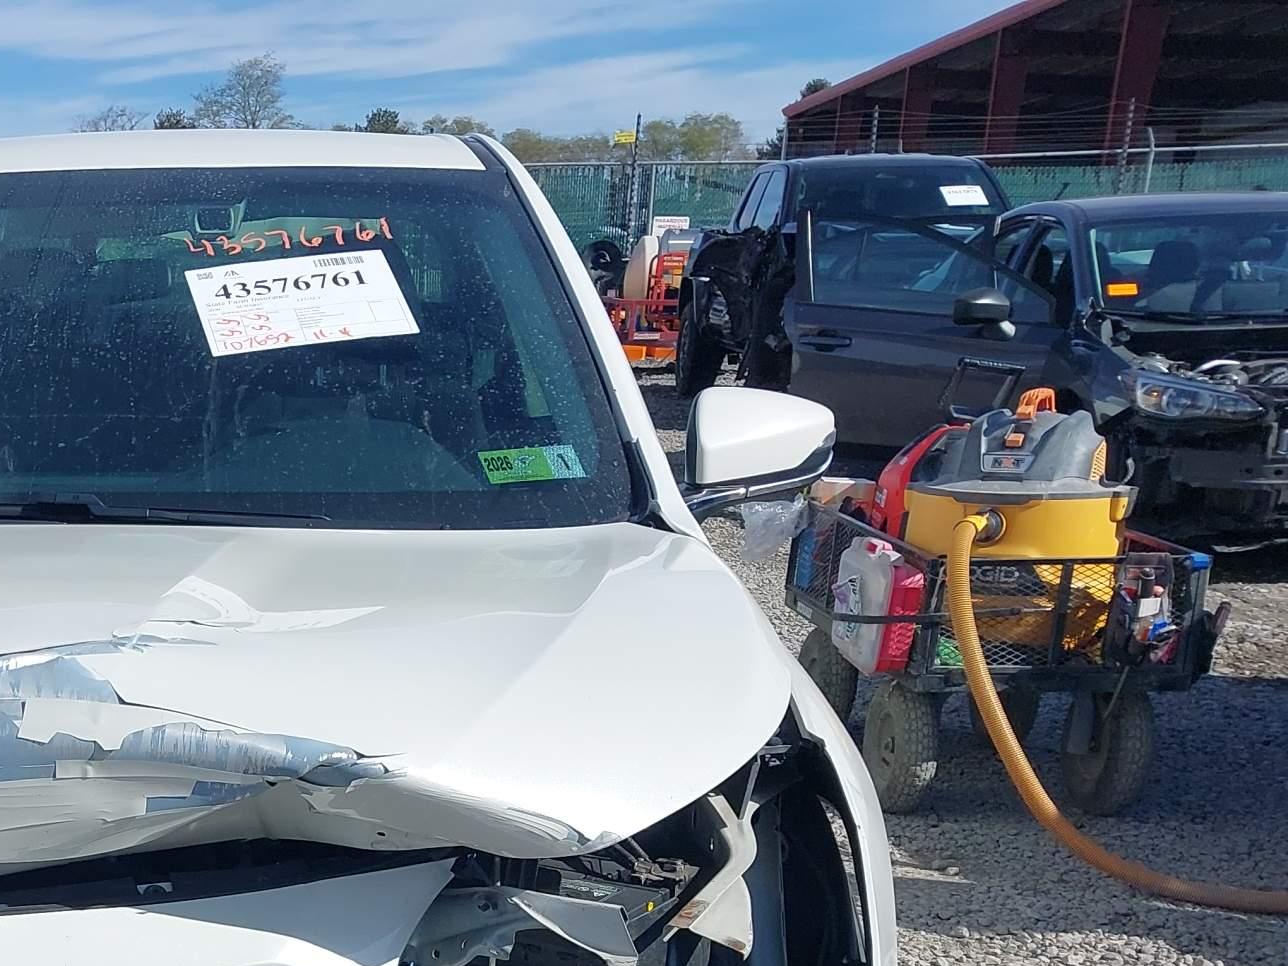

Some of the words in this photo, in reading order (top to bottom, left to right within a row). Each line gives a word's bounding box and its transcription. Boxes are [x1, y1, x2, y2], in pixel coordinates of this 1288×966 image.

[183, 217, 393, 256] 43576761
[215, 269, 368, 299] 43576761
[483, 455, 514, 472] 2026
